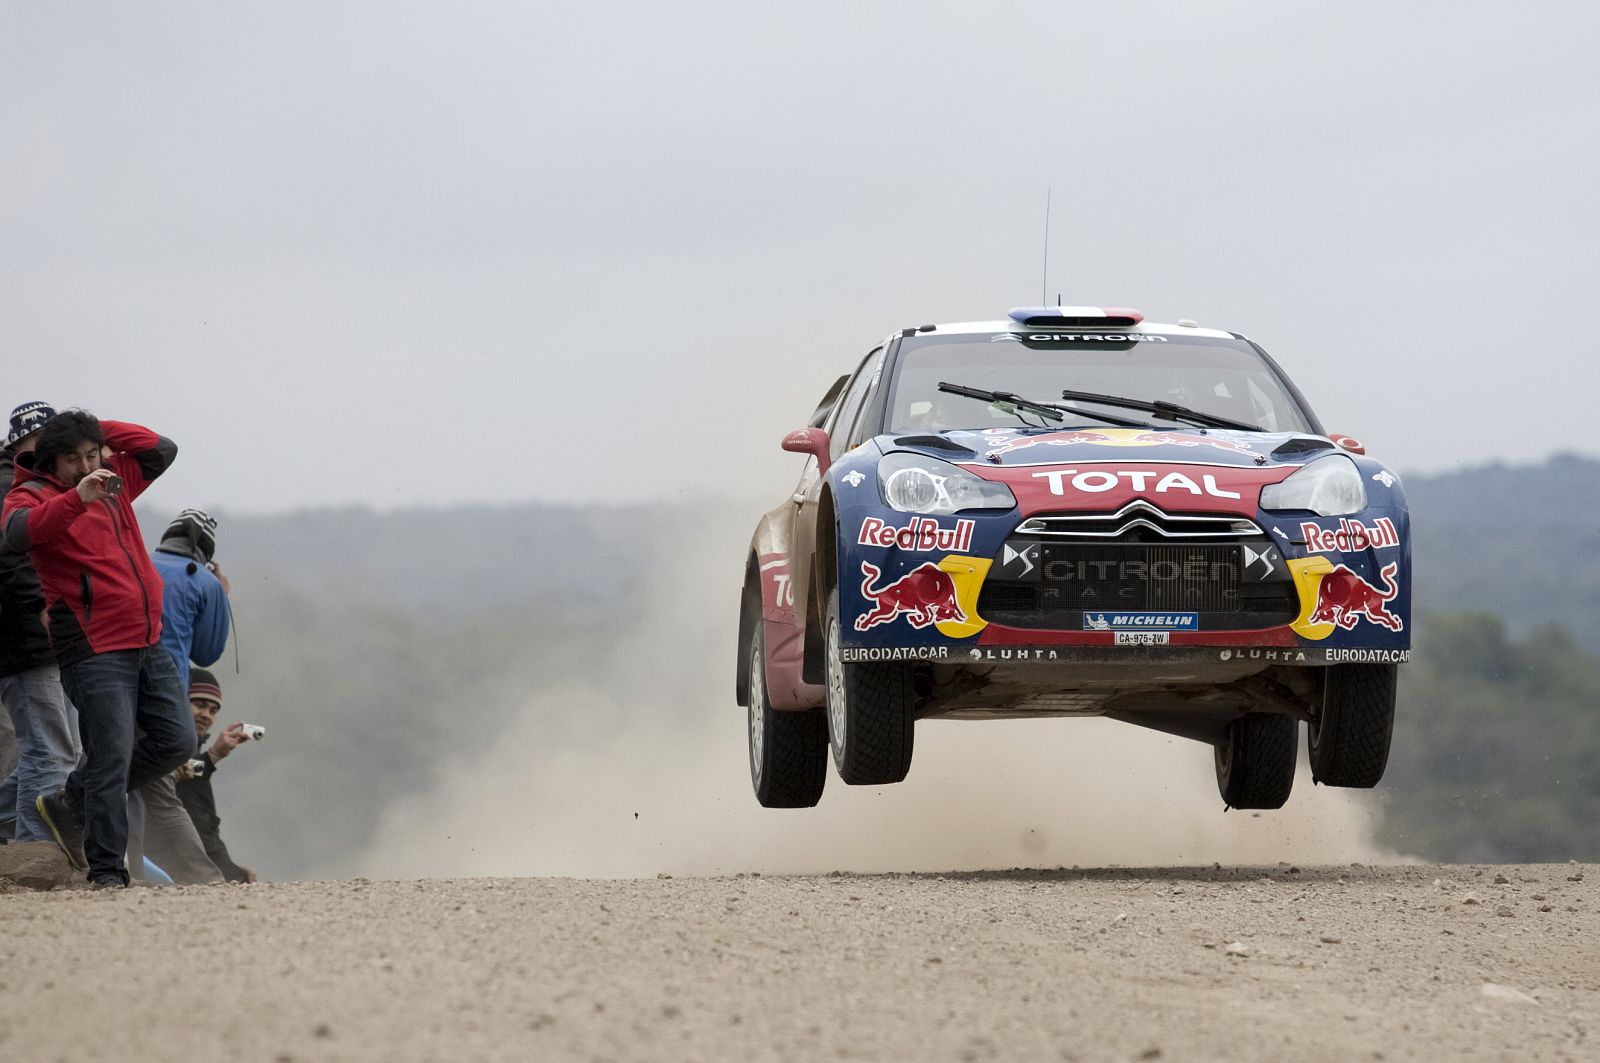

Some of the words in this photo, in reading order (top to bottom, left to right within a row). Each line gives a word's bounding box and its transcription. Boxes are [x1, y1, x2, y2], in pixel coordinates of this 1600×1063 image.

[1032, 469, 1241, 500] TOTAL
[1112, 615, 1193, 626] MICHELIN
[1119, 633, 1165, 643] CA-975-ZW
[843, 646, 948, 661] EURODATACAR
[987, 649, 1058, 660] LUHTA
[1236, 649, 1306, 661] LUHTA
[1325, 648, 1410, 663] EURODATACAR
